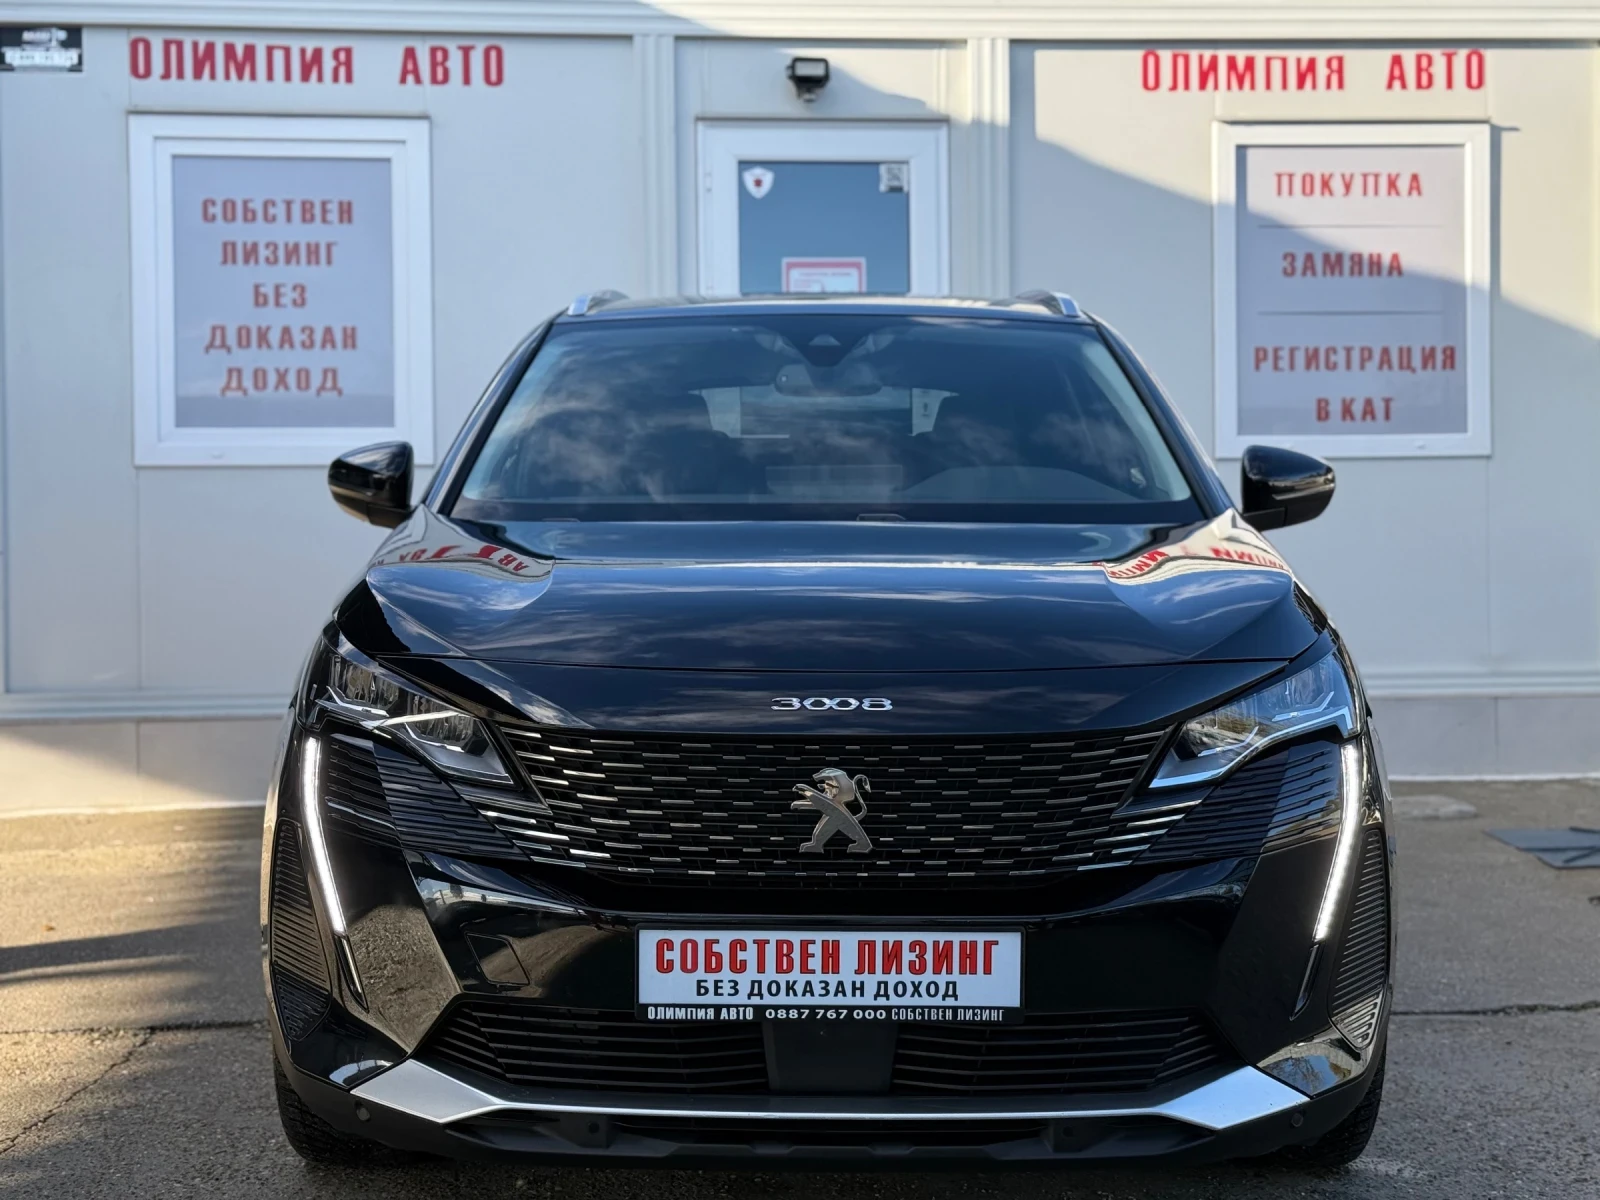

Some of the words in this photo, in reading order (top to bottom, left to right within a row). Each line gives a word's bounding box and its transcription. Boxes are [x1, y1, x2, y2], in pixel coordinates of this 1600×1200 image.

[129, 36, 354, 85] ОЛИМПИЯ
[398, 44, 505, 87] АВТО
[1141, 49, 1346, 92] ОЛИМПИЯ
[1385, 49, 1486, 91] АВТО
[1275, 172, 1424, 198] ПОКУПКА
[201, 198, 354, 225] СОБСТВЕН
[220, 241, 339, 267] ЛИЗИНГ
[1282, 252, 1405, 278] ЗАМЯНА
[252, 283, 308, 309] БЕЗ
[204, 324, 359, 355] ДОКАЗАН
[1253, 345, 1457, 375] РЕГИСТРАЦИЯ
[220, 367, 343, 397] ДОХОД
[1315, 398, 1331, 423] В
[1341, 398, 1396, 423] КАТ
[770, 697, 894, 711] 3008
[655, 938, 841, 976] СОБСТВЕН
[854, 939, 1000, 976] ЛИЗИНГ
[696, 979, 740, 998] БЕЗ
[747, 979, 866, 1001] ДОКАЗАН
[873, 980, 959, 1002] ДОХОД
[647, 1007, 715, 1021] ОЛИМПИЯ
[719, 1008, 754, 1021] АВТО
[765, 1009, 810, 1020] 0887
[815, 1009, 849, 1020] 767
[852, 1009, 887, 1020] 000
[891, 1009, 953, 1021] СОБСТВЕН
[956, 1009, 1005, 1022] ЛИЗИНГ
